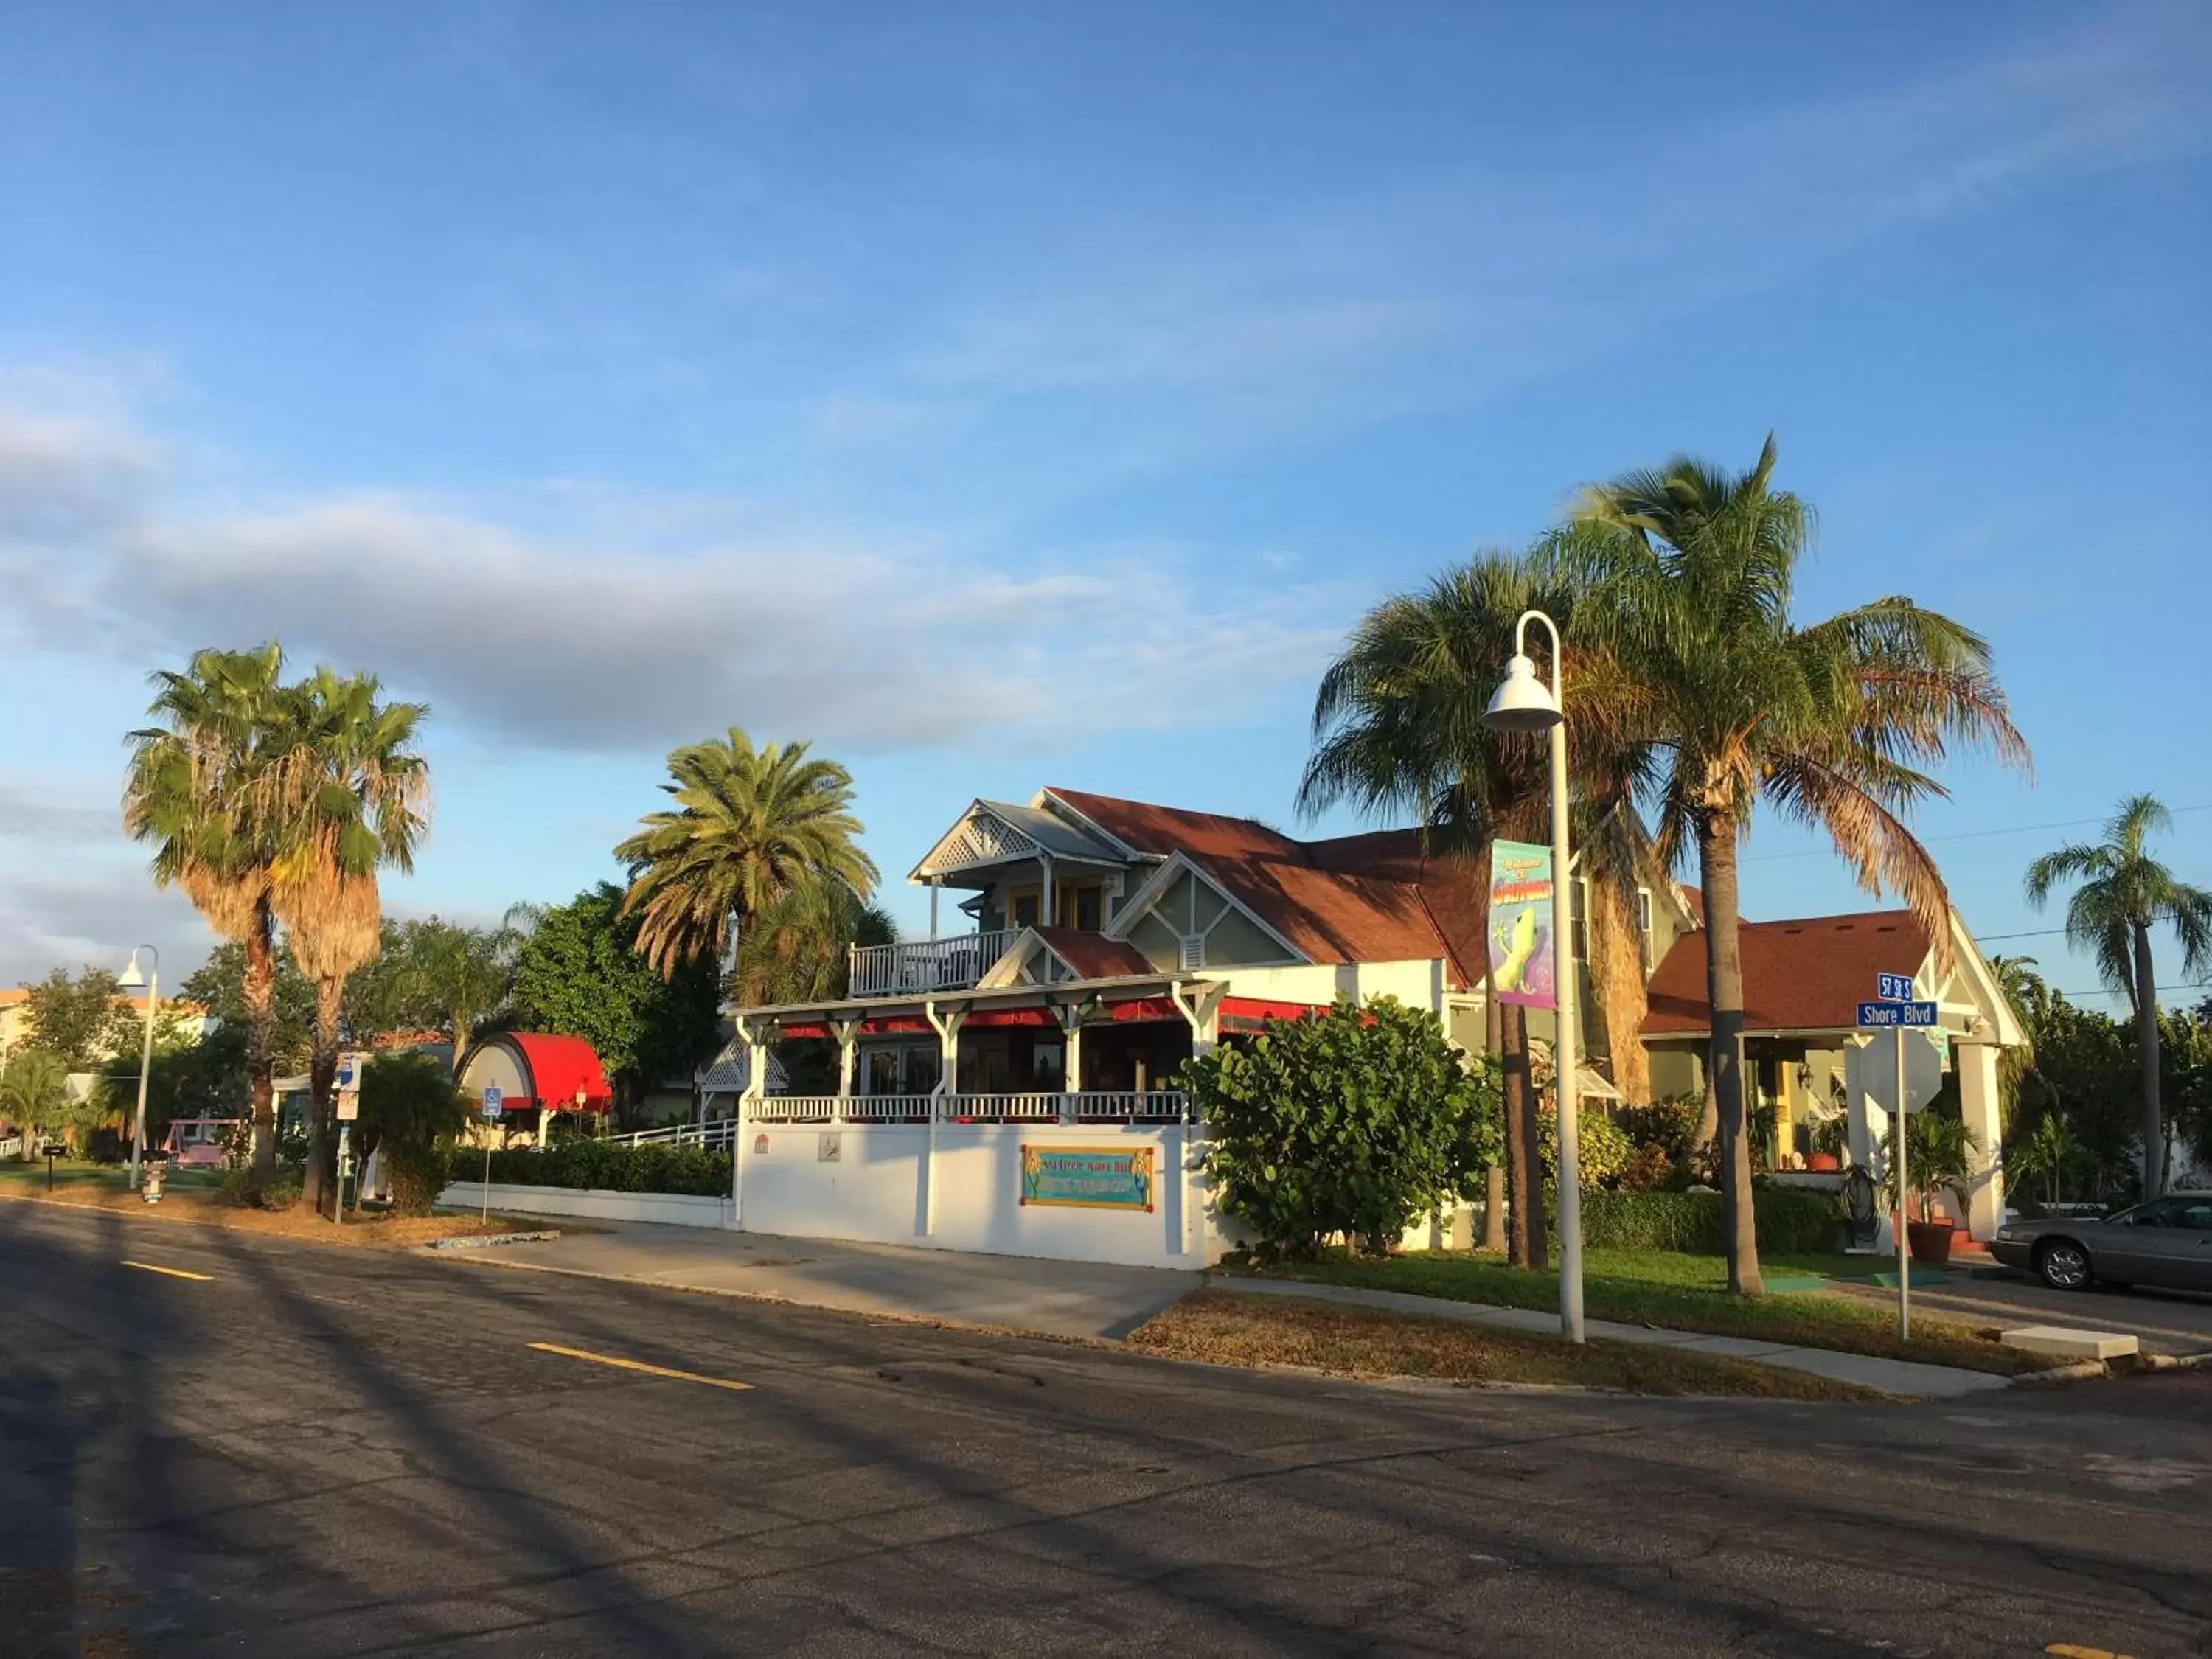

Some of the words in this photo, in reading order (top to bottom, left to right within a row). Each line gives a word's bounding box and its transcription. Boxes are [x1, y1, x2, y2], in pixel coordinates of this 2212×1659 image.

[1905, 980, 1910, 999] S
[1865, 1005, 1897, 1024] Shore
[1904, 1005, 1931, 1023] Blvd
